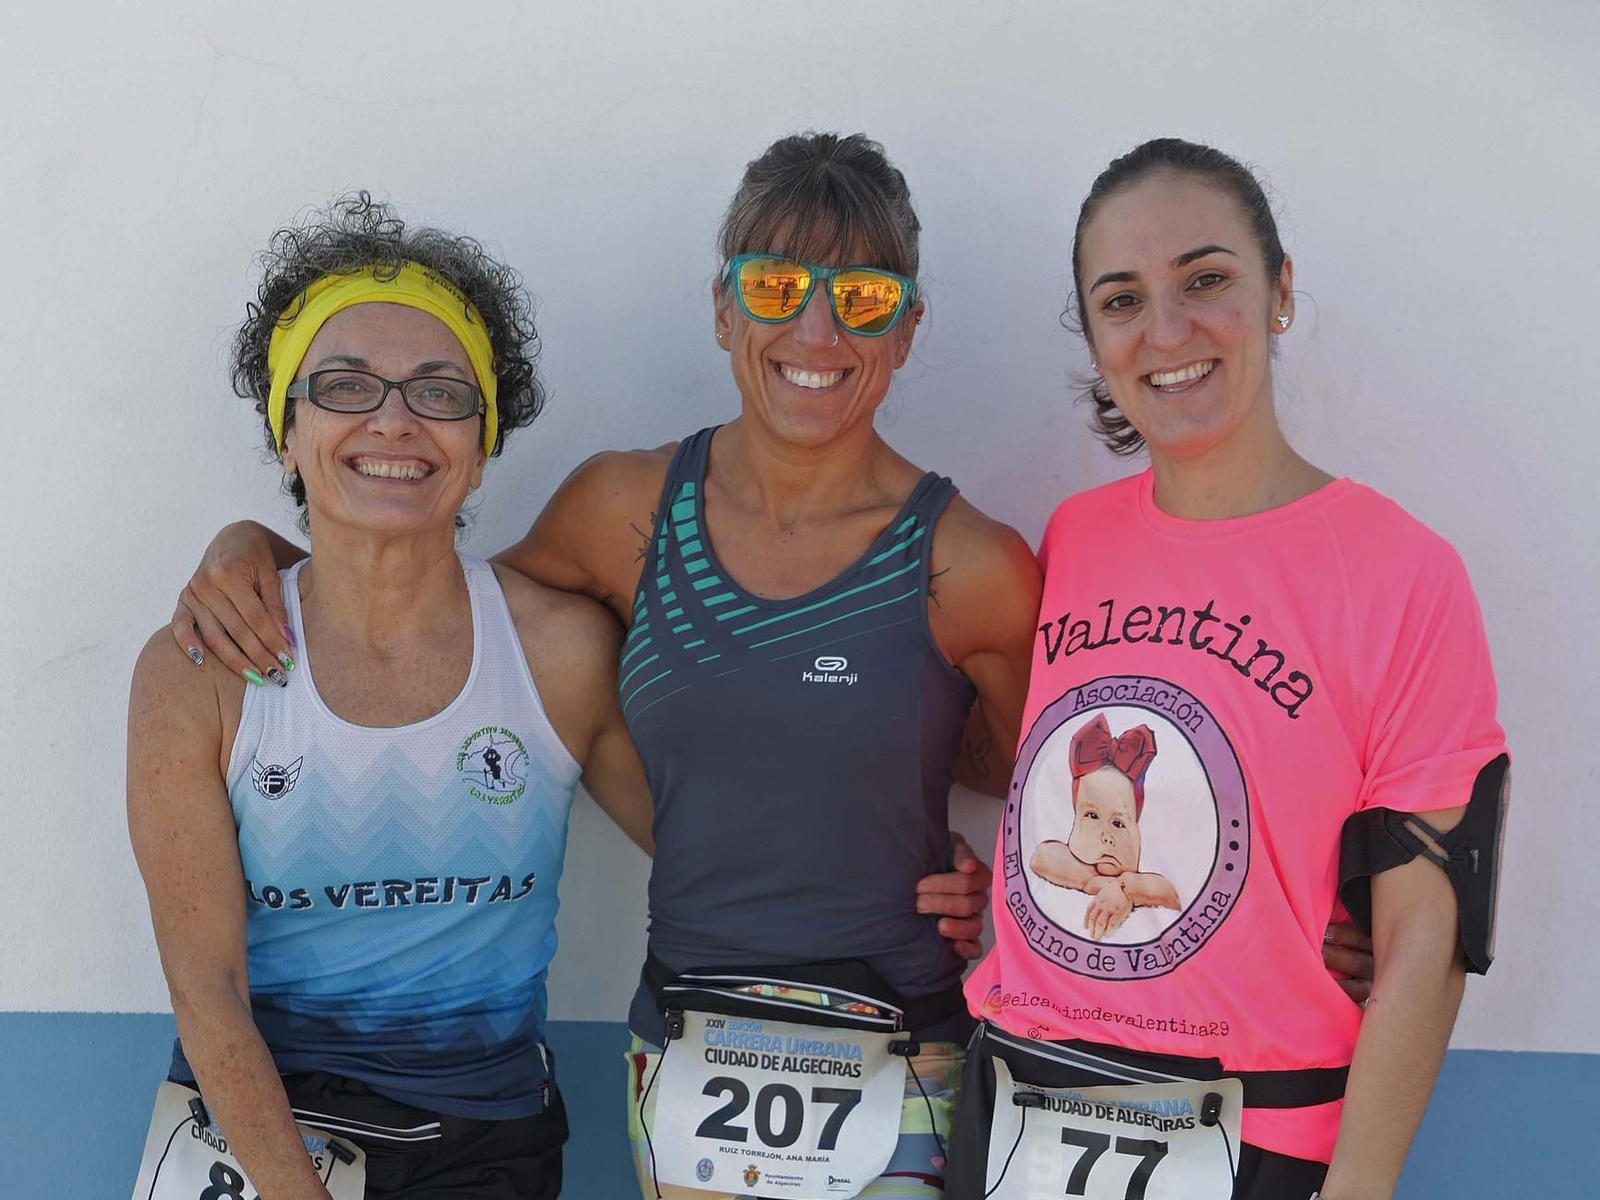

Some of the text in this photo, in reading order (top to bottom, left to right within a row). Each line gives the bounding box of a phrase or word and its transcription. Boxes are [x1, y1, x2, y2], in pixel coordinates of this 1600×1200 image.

[1038, 599, 1314, 719] Valentina
[801, 671, 858, 686] Kalenji
[1072, 679, 1204, 734] Asociación
[1004, 850, 1020, 888] El
[323, 871, 536, 911] VEREITAS
[1009, 891, 1079, 963] camino
[1086, 948, 1116, 972] de
[705, 1018, 726, 1030] XXIV
[704, 1028, 864, 1061] CARRERA URBANA
[704, 1048, 861, 1078] CIUDAD DE ALGECIRAS
[695, 1076, 863, 1151] 207
[1042, 1096, 1093, 1117] IUDAD
[1096, 1104, 1114, 1121] DE
[1116, 1107, 1196, 1133] ALGECIRAS
[719, 1146, 739, 1155] RUIZ
[765, 1173, 804, 1182] Ayuntamiento
[776, 1180, 801, 1188] Algeciras
